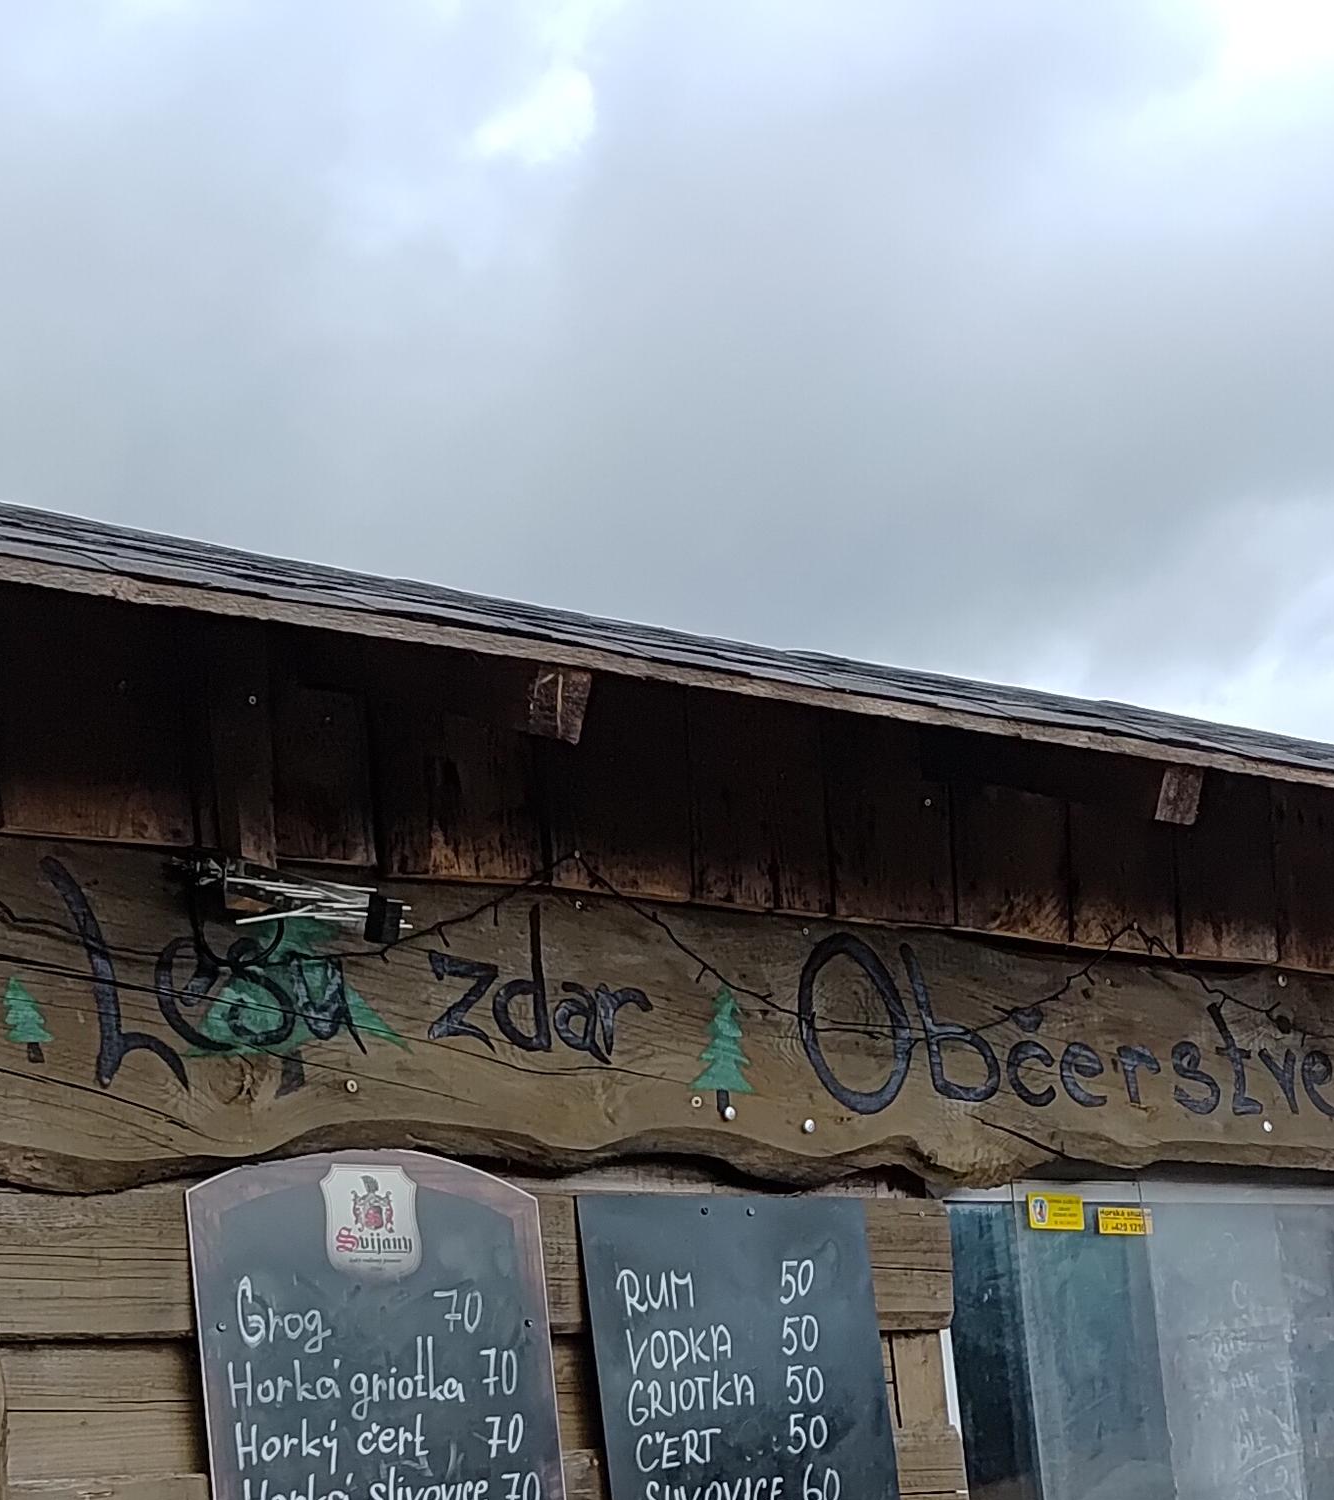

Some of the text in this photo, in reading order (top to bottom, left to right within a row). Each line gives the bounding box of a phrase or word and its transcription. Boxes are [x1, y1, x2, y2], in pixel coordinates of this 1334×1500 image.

[427, 903, 653, 1064] zdar
[335, 1226, 413, 1255] Svijany
[236, 1275, 483, 1353] Grog 70
[616, 1259, 814, 1317] RUM 50
[625, 1314, 818, 1375] VODKA 50
[228, 1336, 518, 1421] Horká griotka 70
[628, 1364, 824, 1426] GRIOTKA 50
[234, 1413, 524, 1475] Horký čert 70
[635, 1413, 828, 1473] ČERT 50
